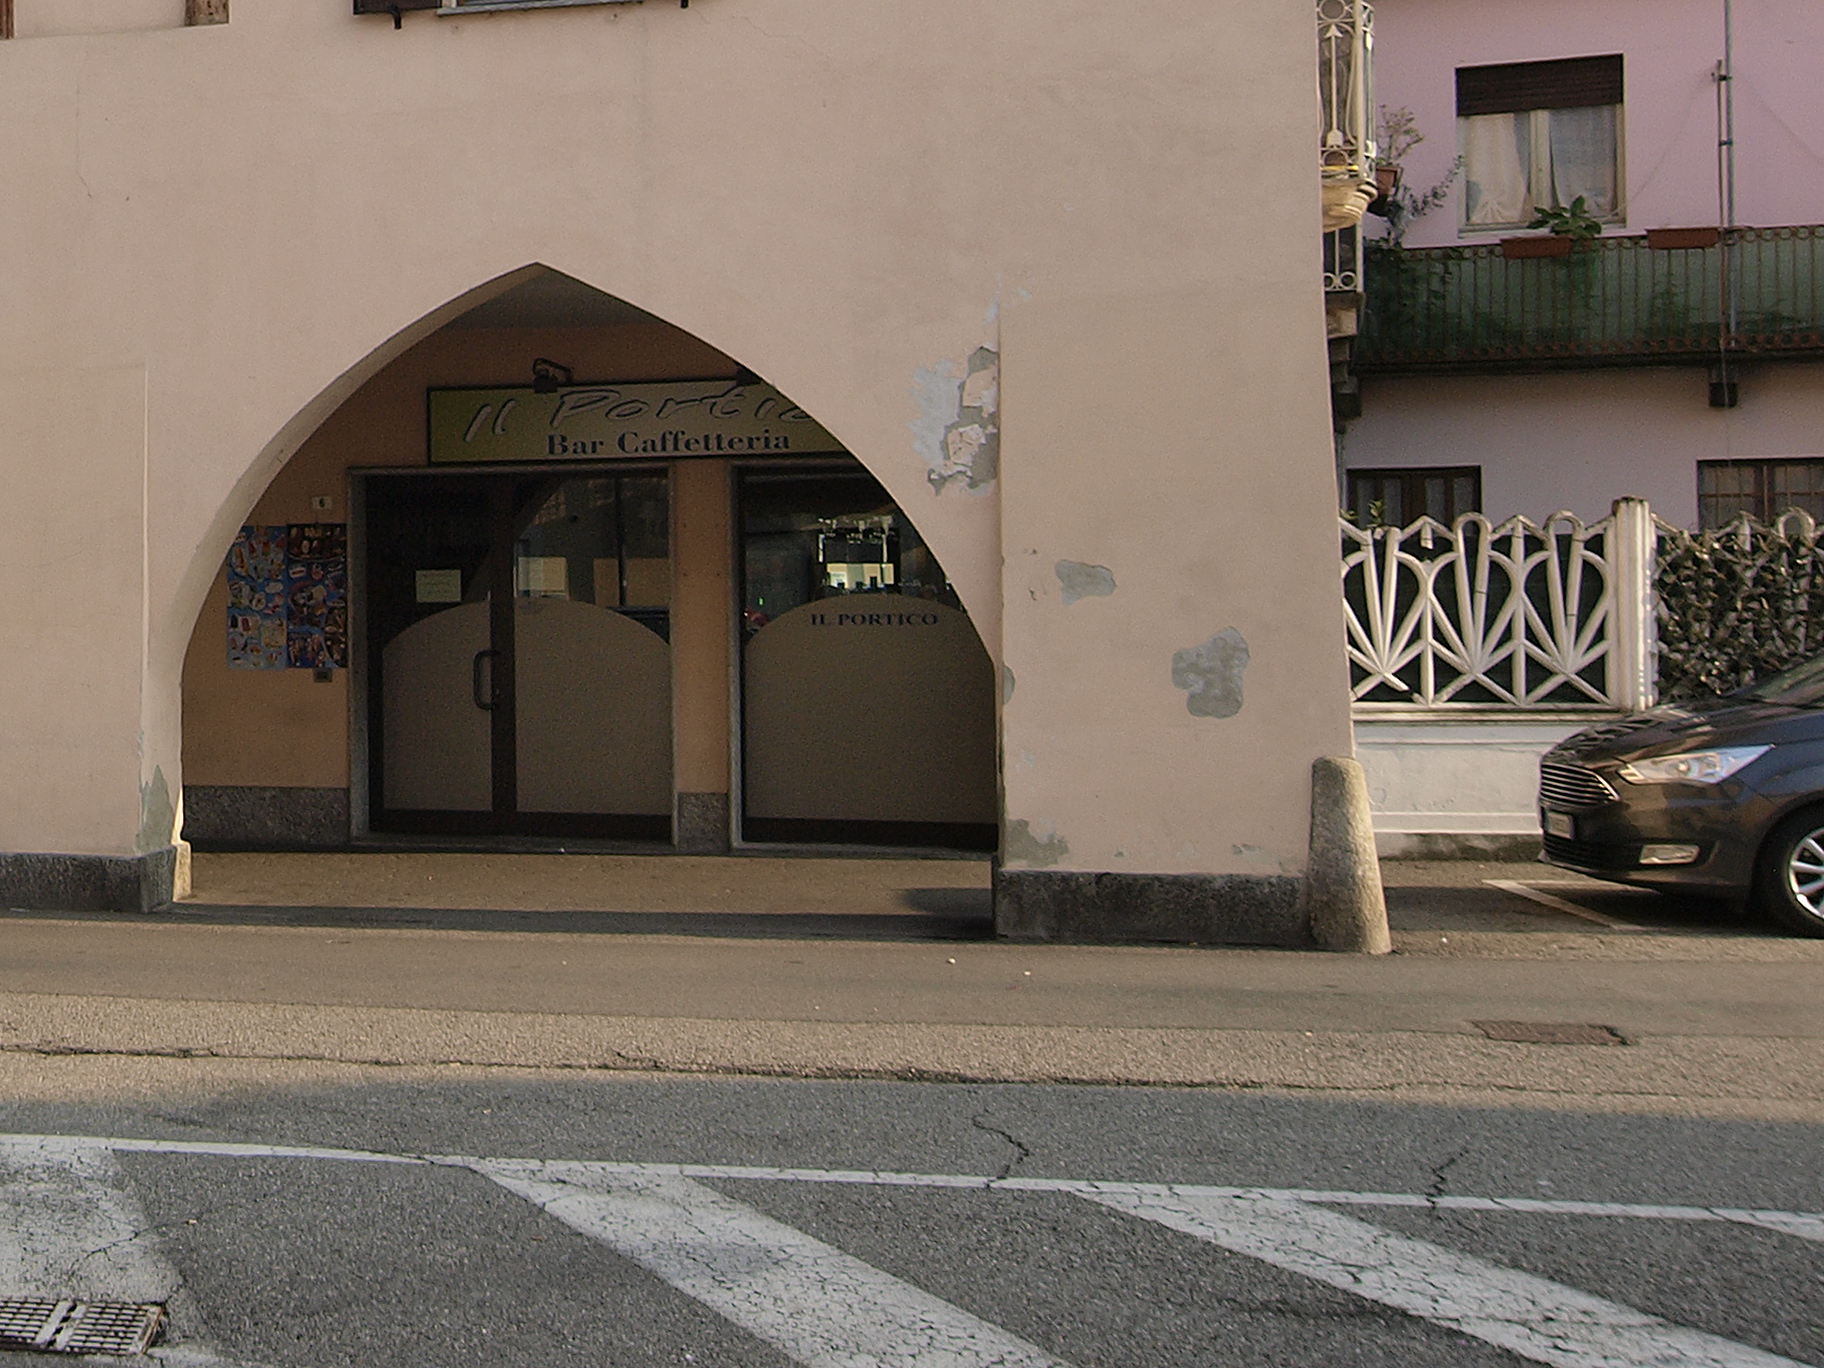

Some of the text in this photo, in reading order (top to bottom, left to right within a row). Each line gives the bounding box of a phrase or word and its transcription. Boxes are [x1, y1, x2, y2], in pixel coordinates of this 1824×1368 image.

[550, 386, 813, 427] Portic
[546, 428, 790, 456] Bar Caffetteria
[810, 613, 939, 626] IL PORTICO
